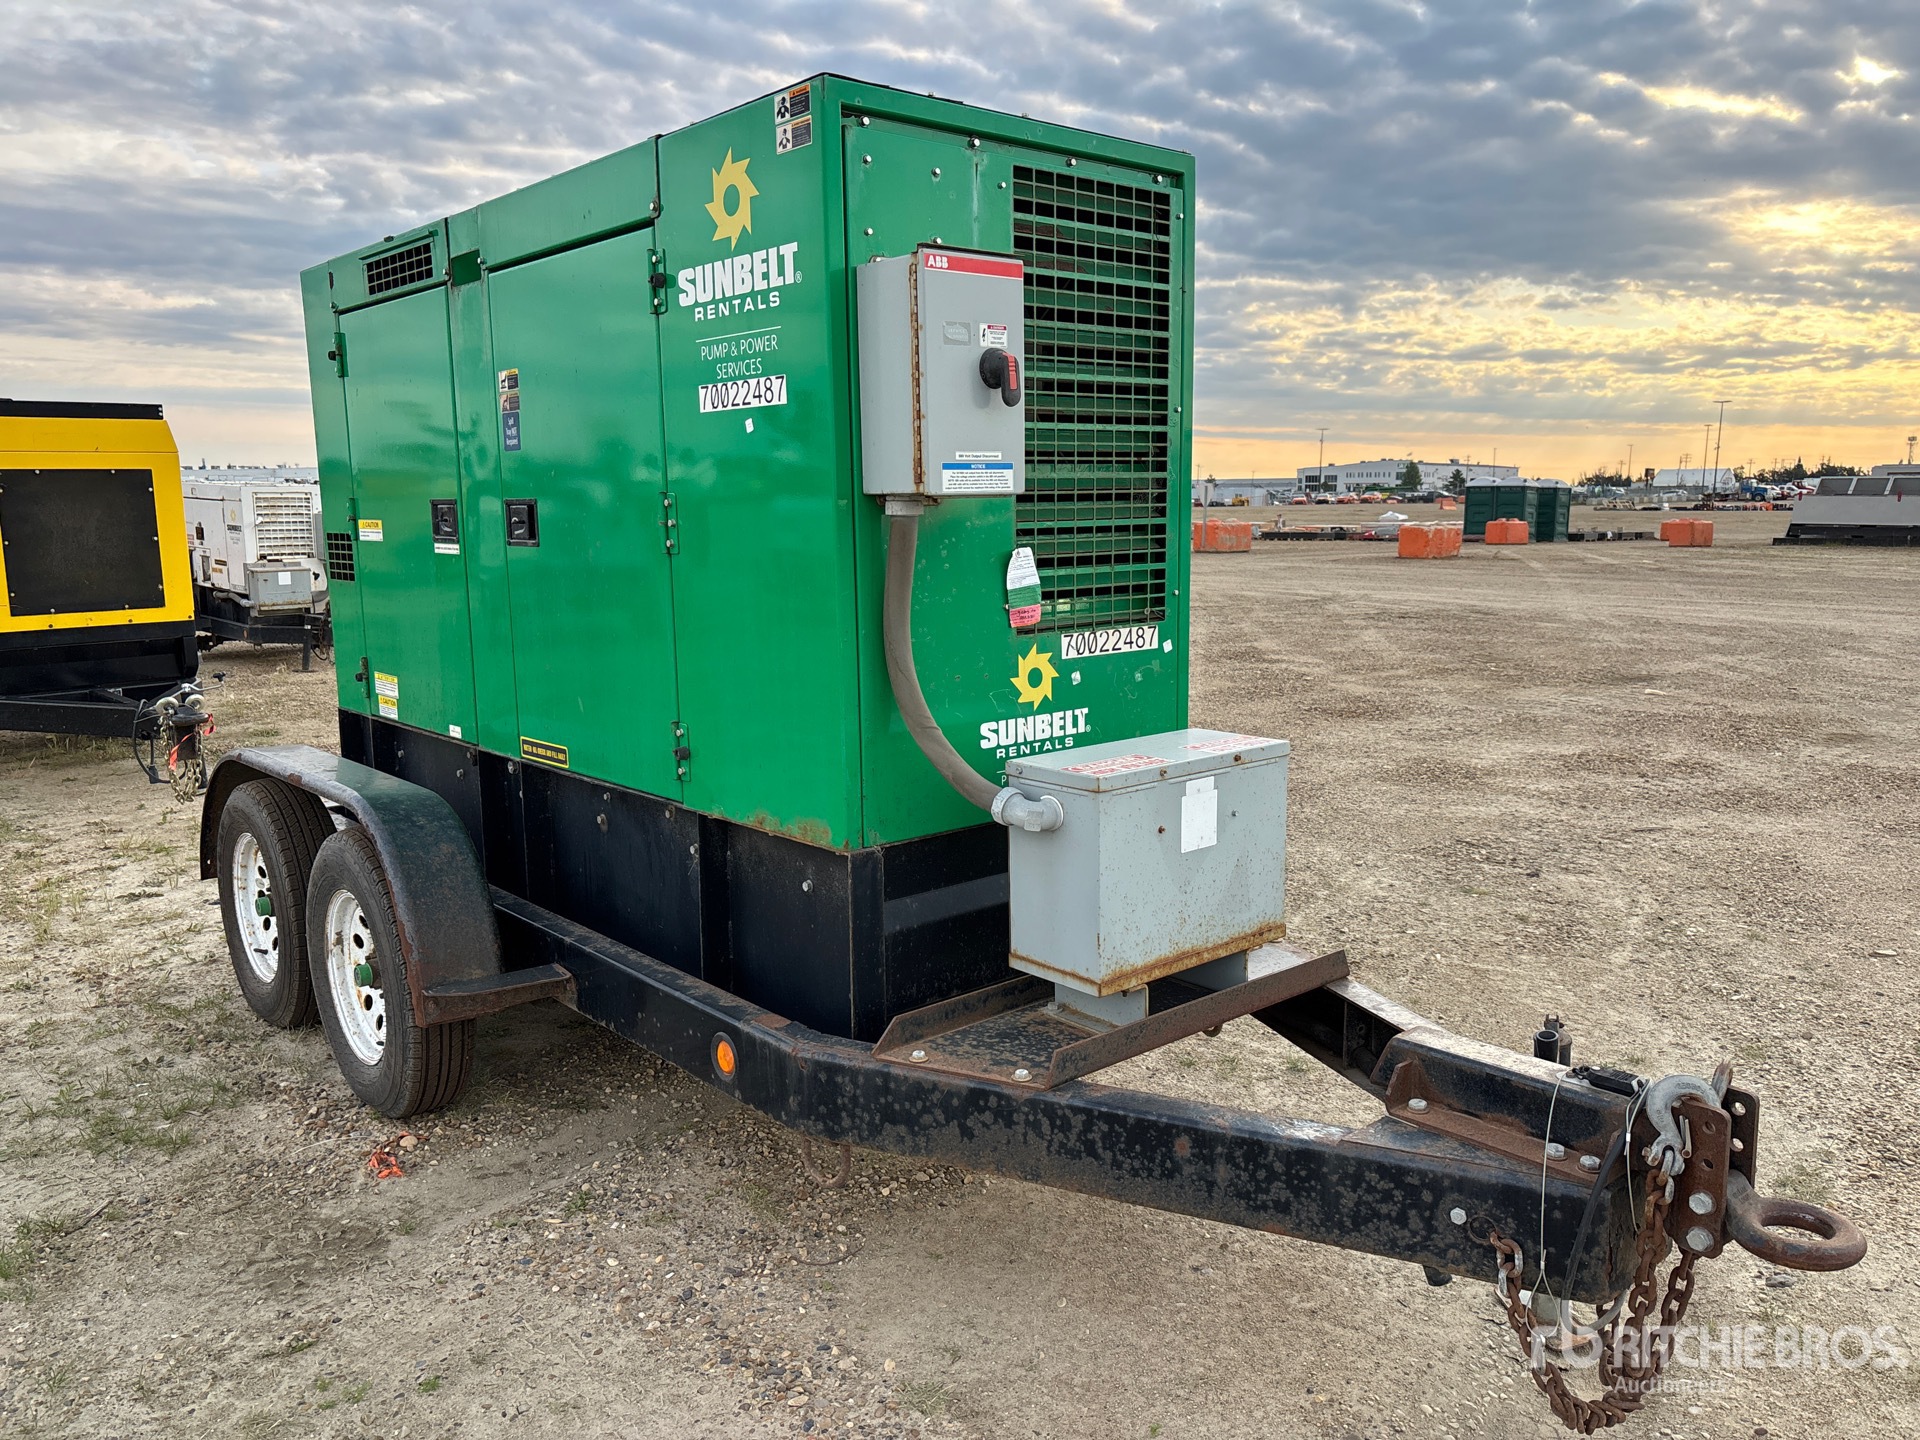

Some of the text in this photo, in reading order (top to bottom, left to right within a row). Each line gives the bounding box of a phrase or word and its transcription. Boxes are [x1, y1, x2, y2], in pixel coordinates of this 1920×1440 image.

[927, 254, 949, 269] ABB
[694, 291, 780, 322] RENTALS
[701, 334, 778, 361] PUMP & POWER
[716, 358, 763, 380] SERVICES
[700, 375, 785, 411] 70022487
[1063, 625, 1157, 657] 70022487
[996, 736, 1074, 759] RENTALS
